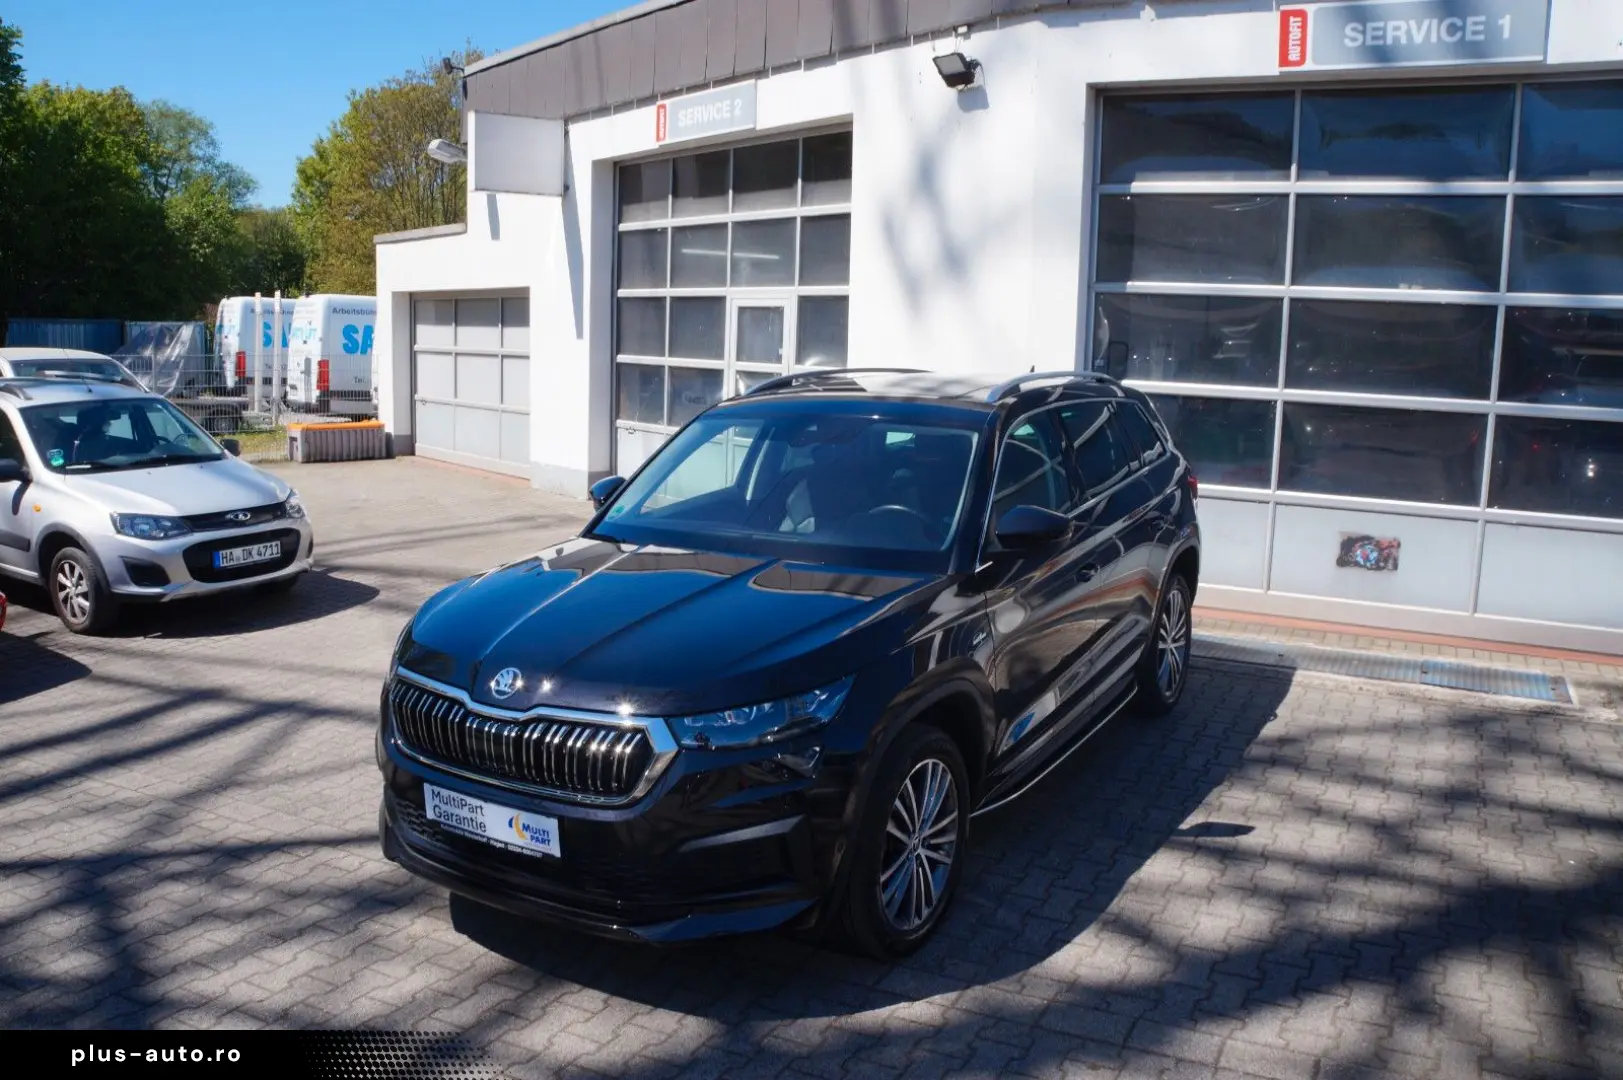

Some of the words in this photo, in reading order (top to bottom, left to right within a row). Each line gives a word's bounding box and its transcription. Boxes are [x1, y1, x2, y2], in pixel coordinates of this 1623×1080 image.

[1288, 15, 1303, 61] AUTOFIT
[1344, 16, 1485, 46] SERVICE
[1498, 14, 1512, 39] 1
[678, 101, 731, 127] SERVICE
[734, 98, 743, 116] 2
[221, 551, 234, 564] HA
[242, 548, 254, 561] DK
[256, 543, 280, 557] 4711
[431, 788, 485, 817] MultiPart
[433, 804, 487, 833] Garantie
[530, 834, 551, 846] PART
